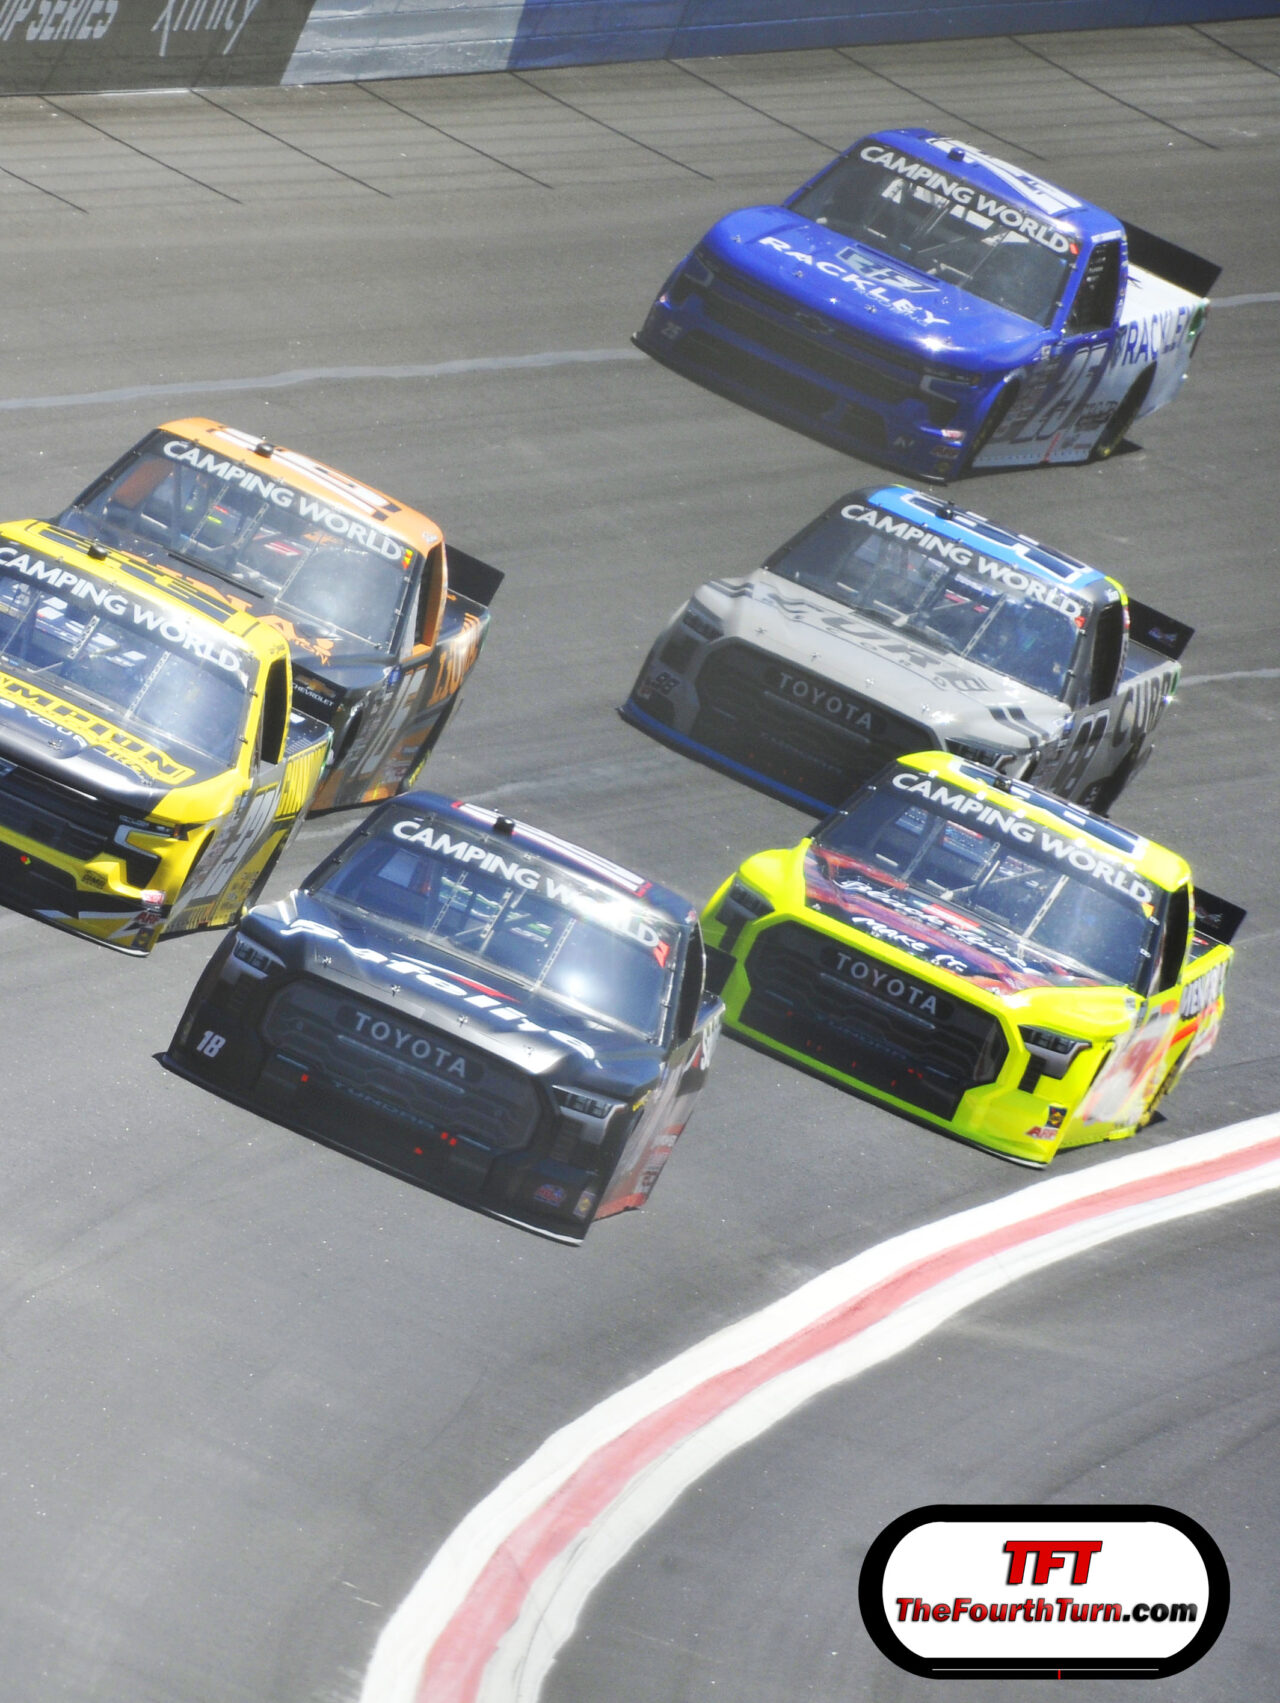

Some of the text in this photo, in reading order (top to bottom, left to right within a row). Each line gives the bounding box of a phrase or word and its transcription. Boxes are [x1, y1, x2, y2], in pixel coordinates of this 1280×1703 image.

[860, 146, 1070, 253] CAMPING WORLD
[759, 237, 950, 325] RACKLEY
[163, 440, 404, 560] CAMPING WORLD
[841, 504, 1082, 619] CAMPING WORLD
[133, 602, 240, 672] WORLD
[24, 708, 88, 749] YOUR
[779, 671, 873, 731] TOYOTA
[892, 773, 1035, 843] CAMPING
[1039, 832, 1152, 903] WORLD
[392, 820, 660, 948] CAMPING WLD
[851, 916, 930, 952] MAKE
[837, 952, 938, 1016] TOYOTA
[196, 1030, 227, 1058] 18
[355, 1011, 466, 1079] TOYOTA
